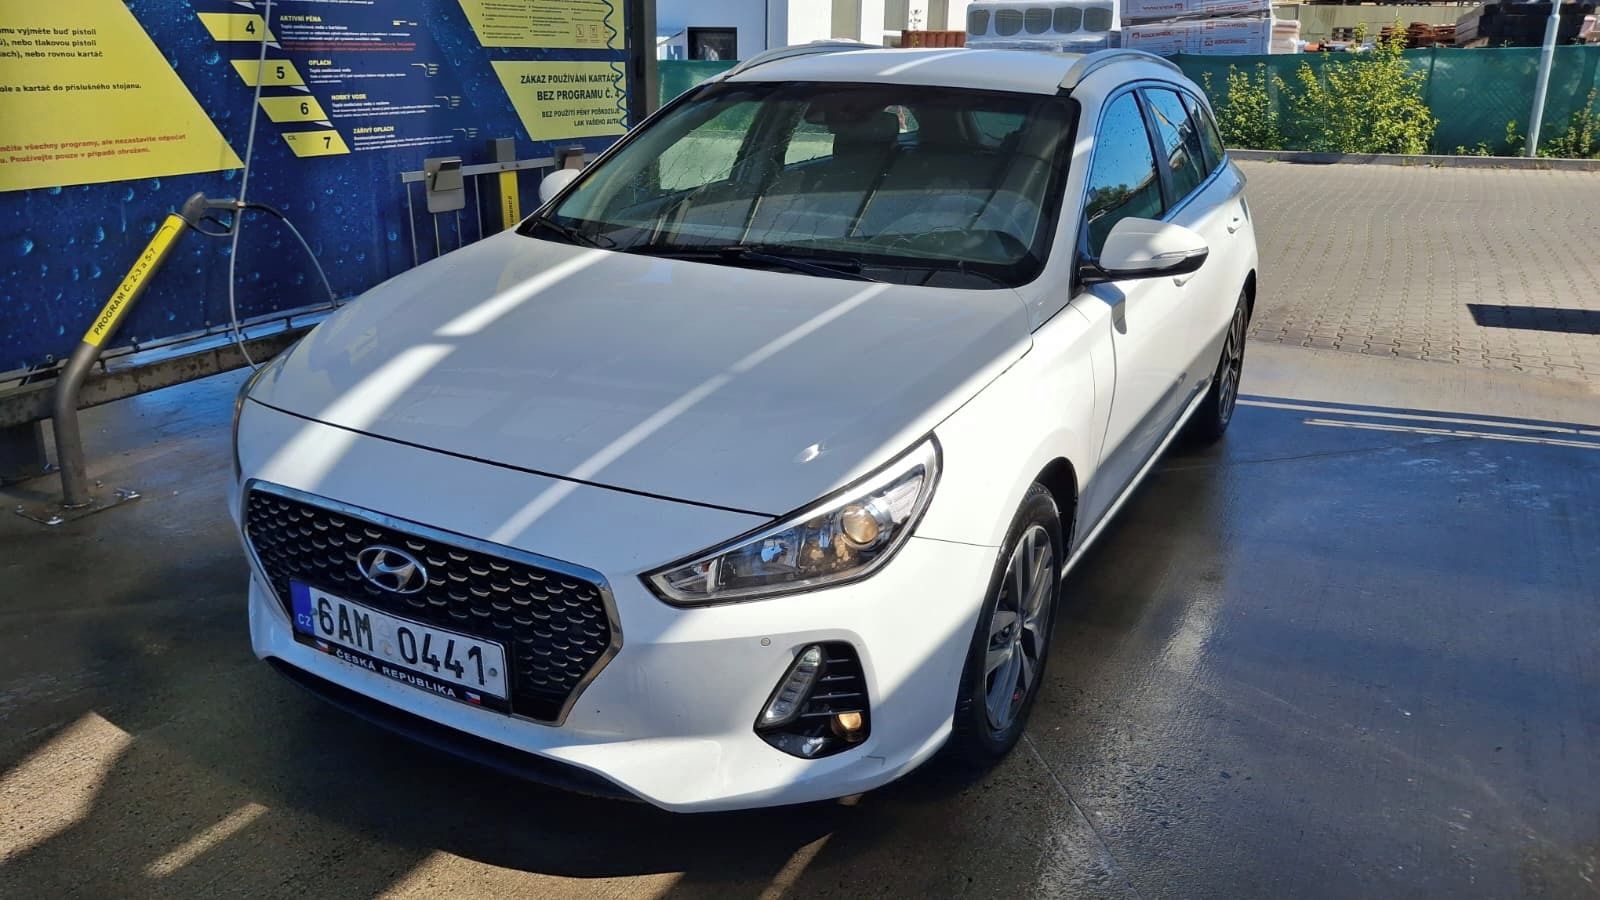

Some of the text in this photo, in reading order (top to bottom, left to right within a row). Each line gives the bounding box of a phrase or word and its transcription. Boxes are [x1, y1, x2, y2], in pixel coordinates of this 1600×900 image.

[72, 28, 97, 36] pistoli
[245, 21, 256, 34] 4
[35, 39, 70, 47] tlakovou
[275, 66, 286, 79] 5
[112, 82, 142, 90] stojanu.
[537, 91, 554, 101] BEZ
[556, 89, 603, 100] PROGRAMU
[299, 102, 310, 115] 6
[323, 136, 332, 149] 7
[94, 292, 126, 336] PROGRAM
[297, 613, 312, 627] CZ
[317, 597, 485, 686] 6AM 0441
[335, 648, 457, 698] ČESKÁ REPUBLIKA
